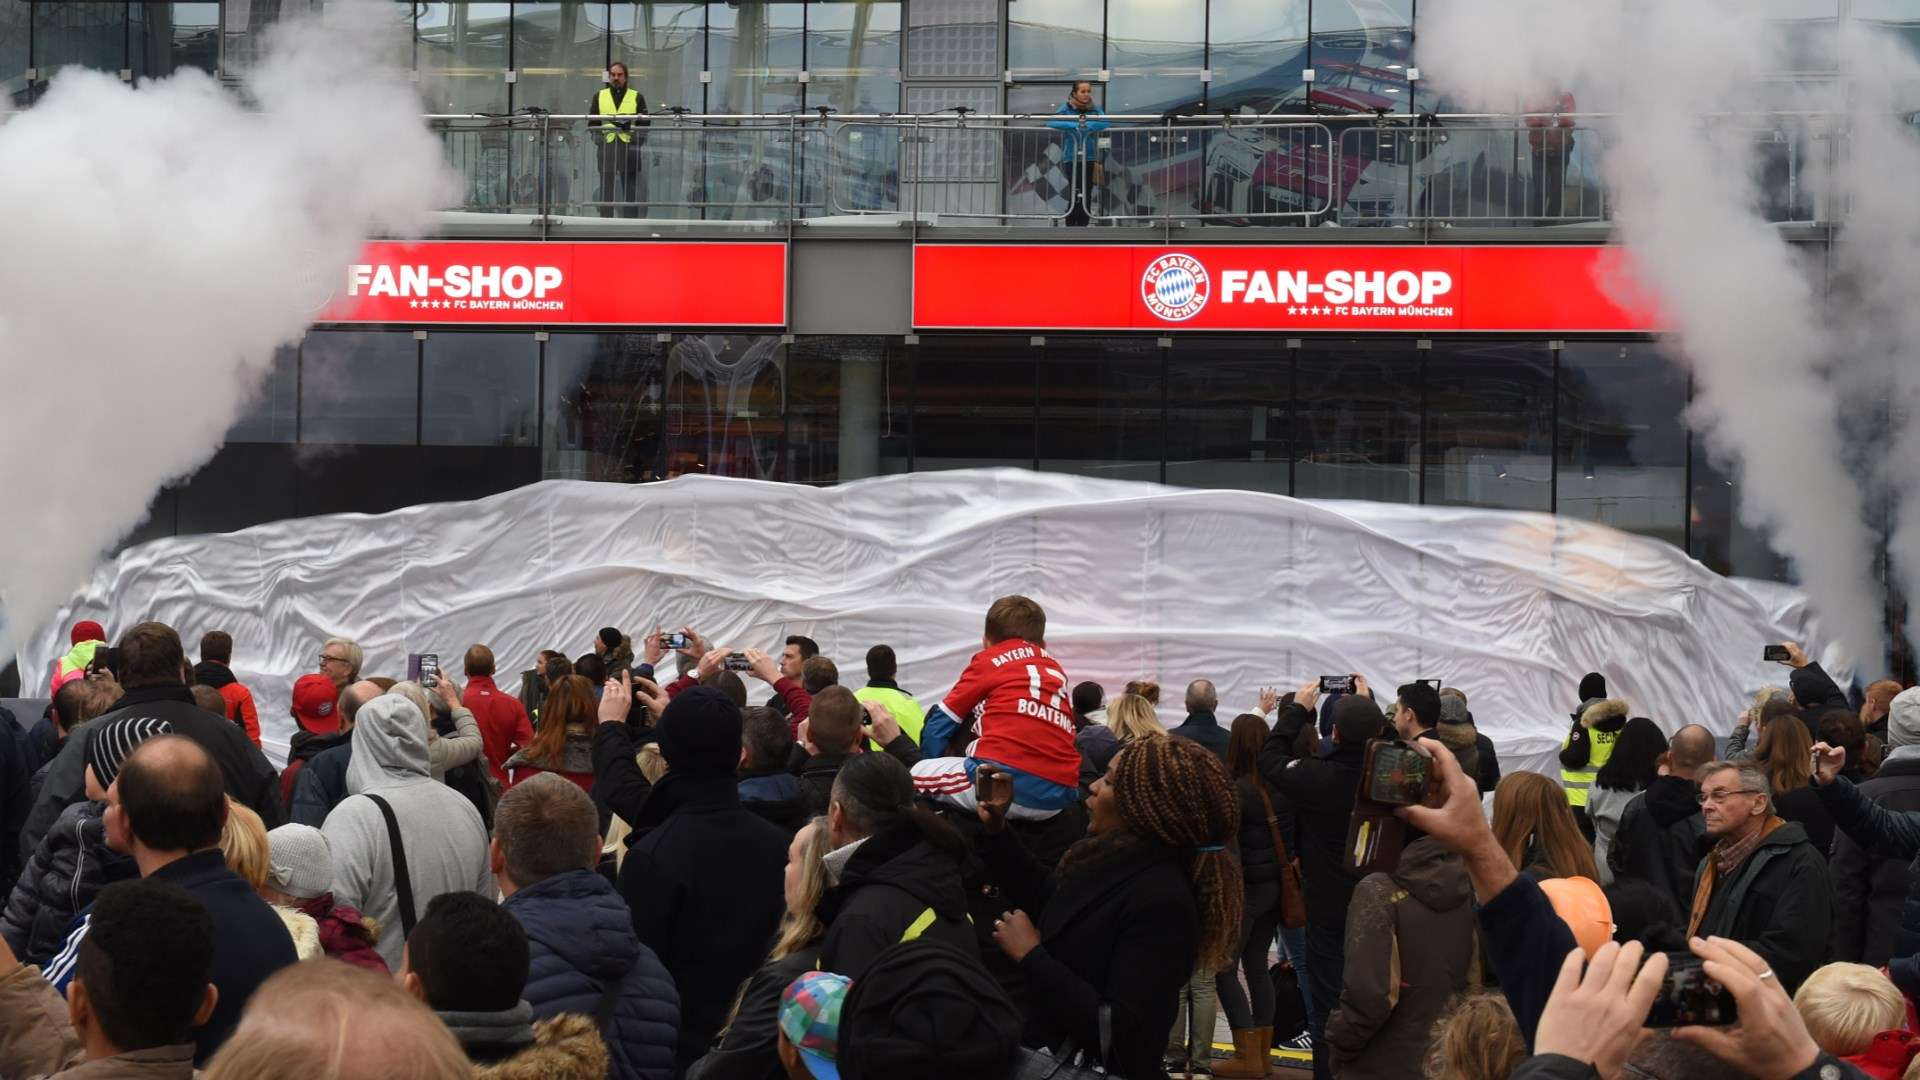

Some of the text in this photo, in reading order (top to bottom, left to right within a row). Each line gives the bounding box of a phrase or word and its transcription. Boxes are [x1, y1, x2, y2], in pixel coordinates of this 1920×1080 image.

[347, 264, 562, 298] FAN-SHOP
[1147, 257, 1205, 284] FC BAYERN
[1221, 270, 1452, 305] FAN-SHOP
[454, 299, 564, 310] FC BAYERN MÜNCHEN
[1335, 304, 1453, 317] FC BAYERN MÜNCHEN
[991, 646, 1035, 668] BAYERN
[1025, 664, 1068, 710] 17
[1596, 731, 1615, 744] SECU
